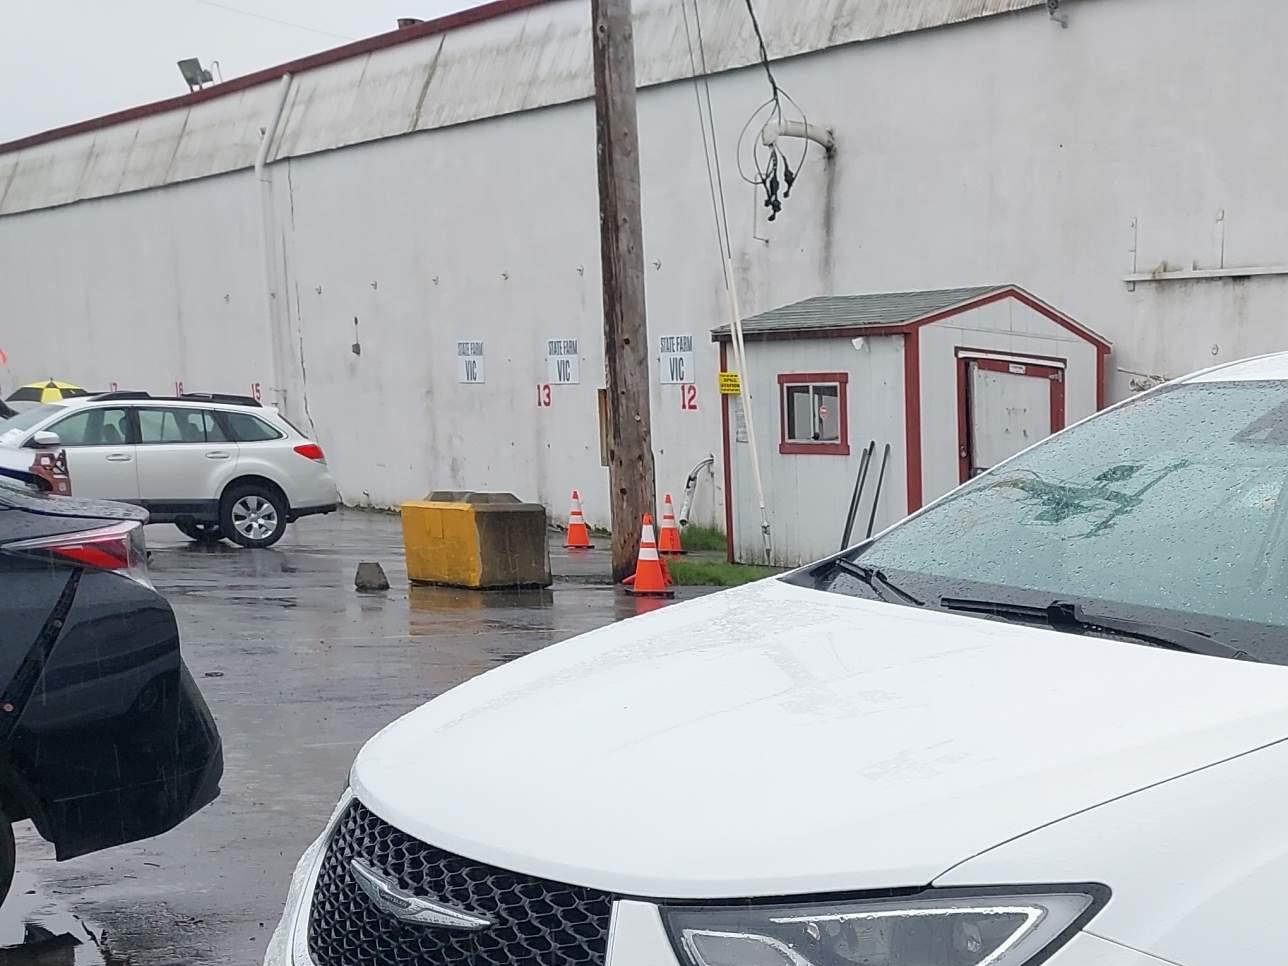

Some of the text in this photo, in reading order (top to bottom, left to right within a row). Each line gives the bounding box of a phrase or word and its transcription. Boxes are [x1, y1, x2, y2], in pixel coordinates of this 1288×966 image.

[548, 339, 578, 356] STATE FARM
[660, 335, 693, 353] STATE FARM
[465, 360, 477, 381] VIC
[557, 360, 571, 382] VIC
[669, 357, 685, 381] VIC
[251, 383, 261, 401] 15
[537, 384, 551, 407] 13
[681, 384, 698, 410] 12
